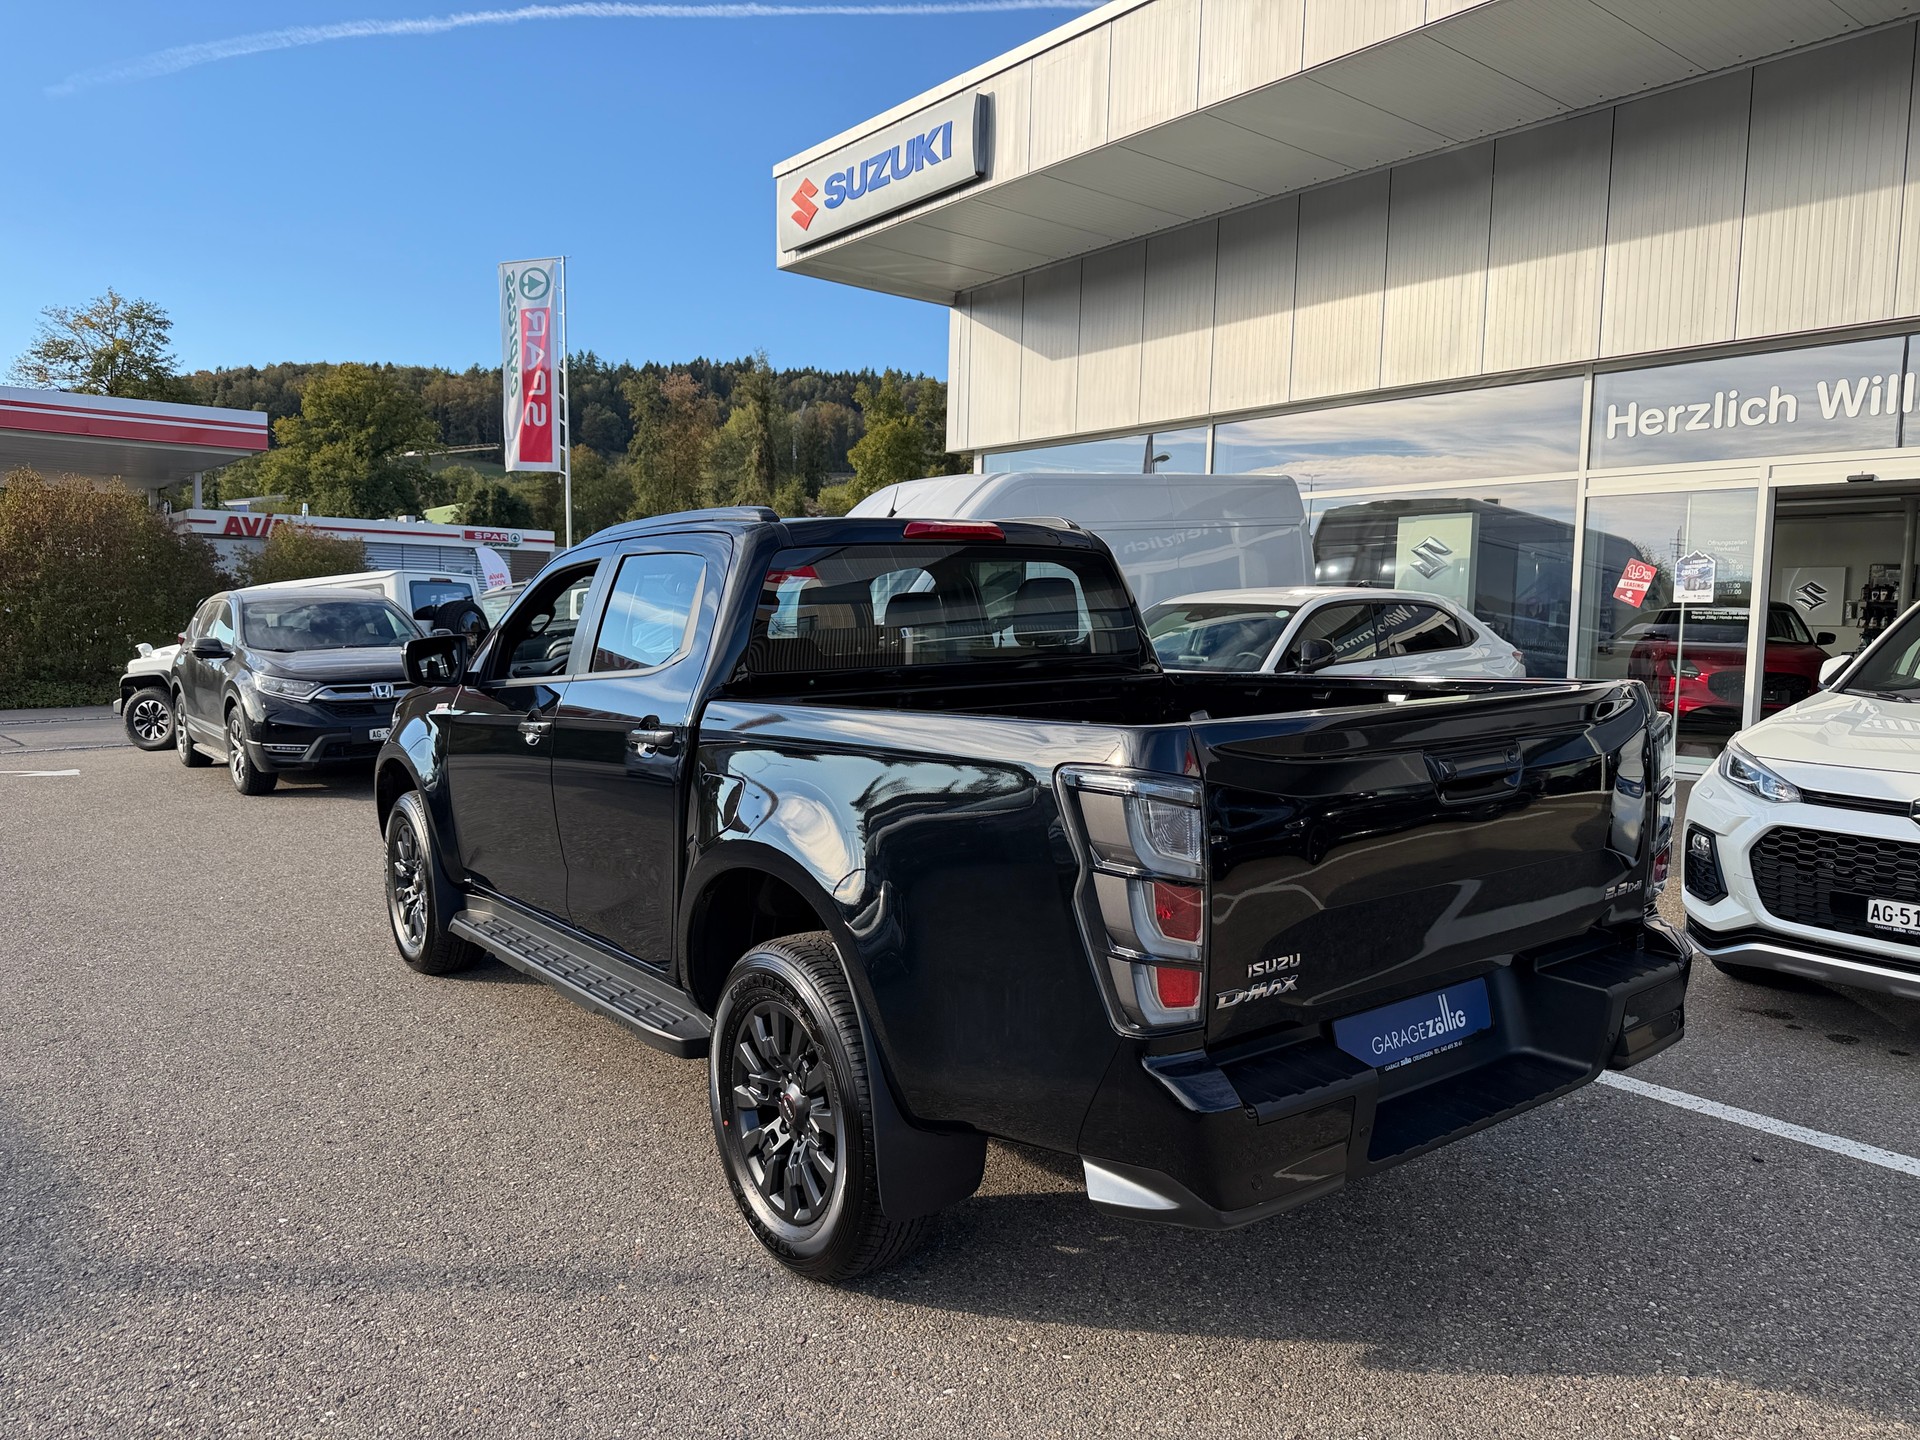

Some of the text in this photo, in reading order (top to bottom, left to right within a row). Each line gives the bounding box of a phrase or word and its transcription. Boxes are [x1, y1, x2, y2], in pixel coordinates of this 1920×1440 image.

[824, 120, 953, 210] SUZUKI
[1606, 371, 1920, 440] Herzlich Will
[474, 531, 509, 541] SPAR
[1623, 581, 1645, 589] LEASING
[1247, 953, 1301, 979] ISUZU
